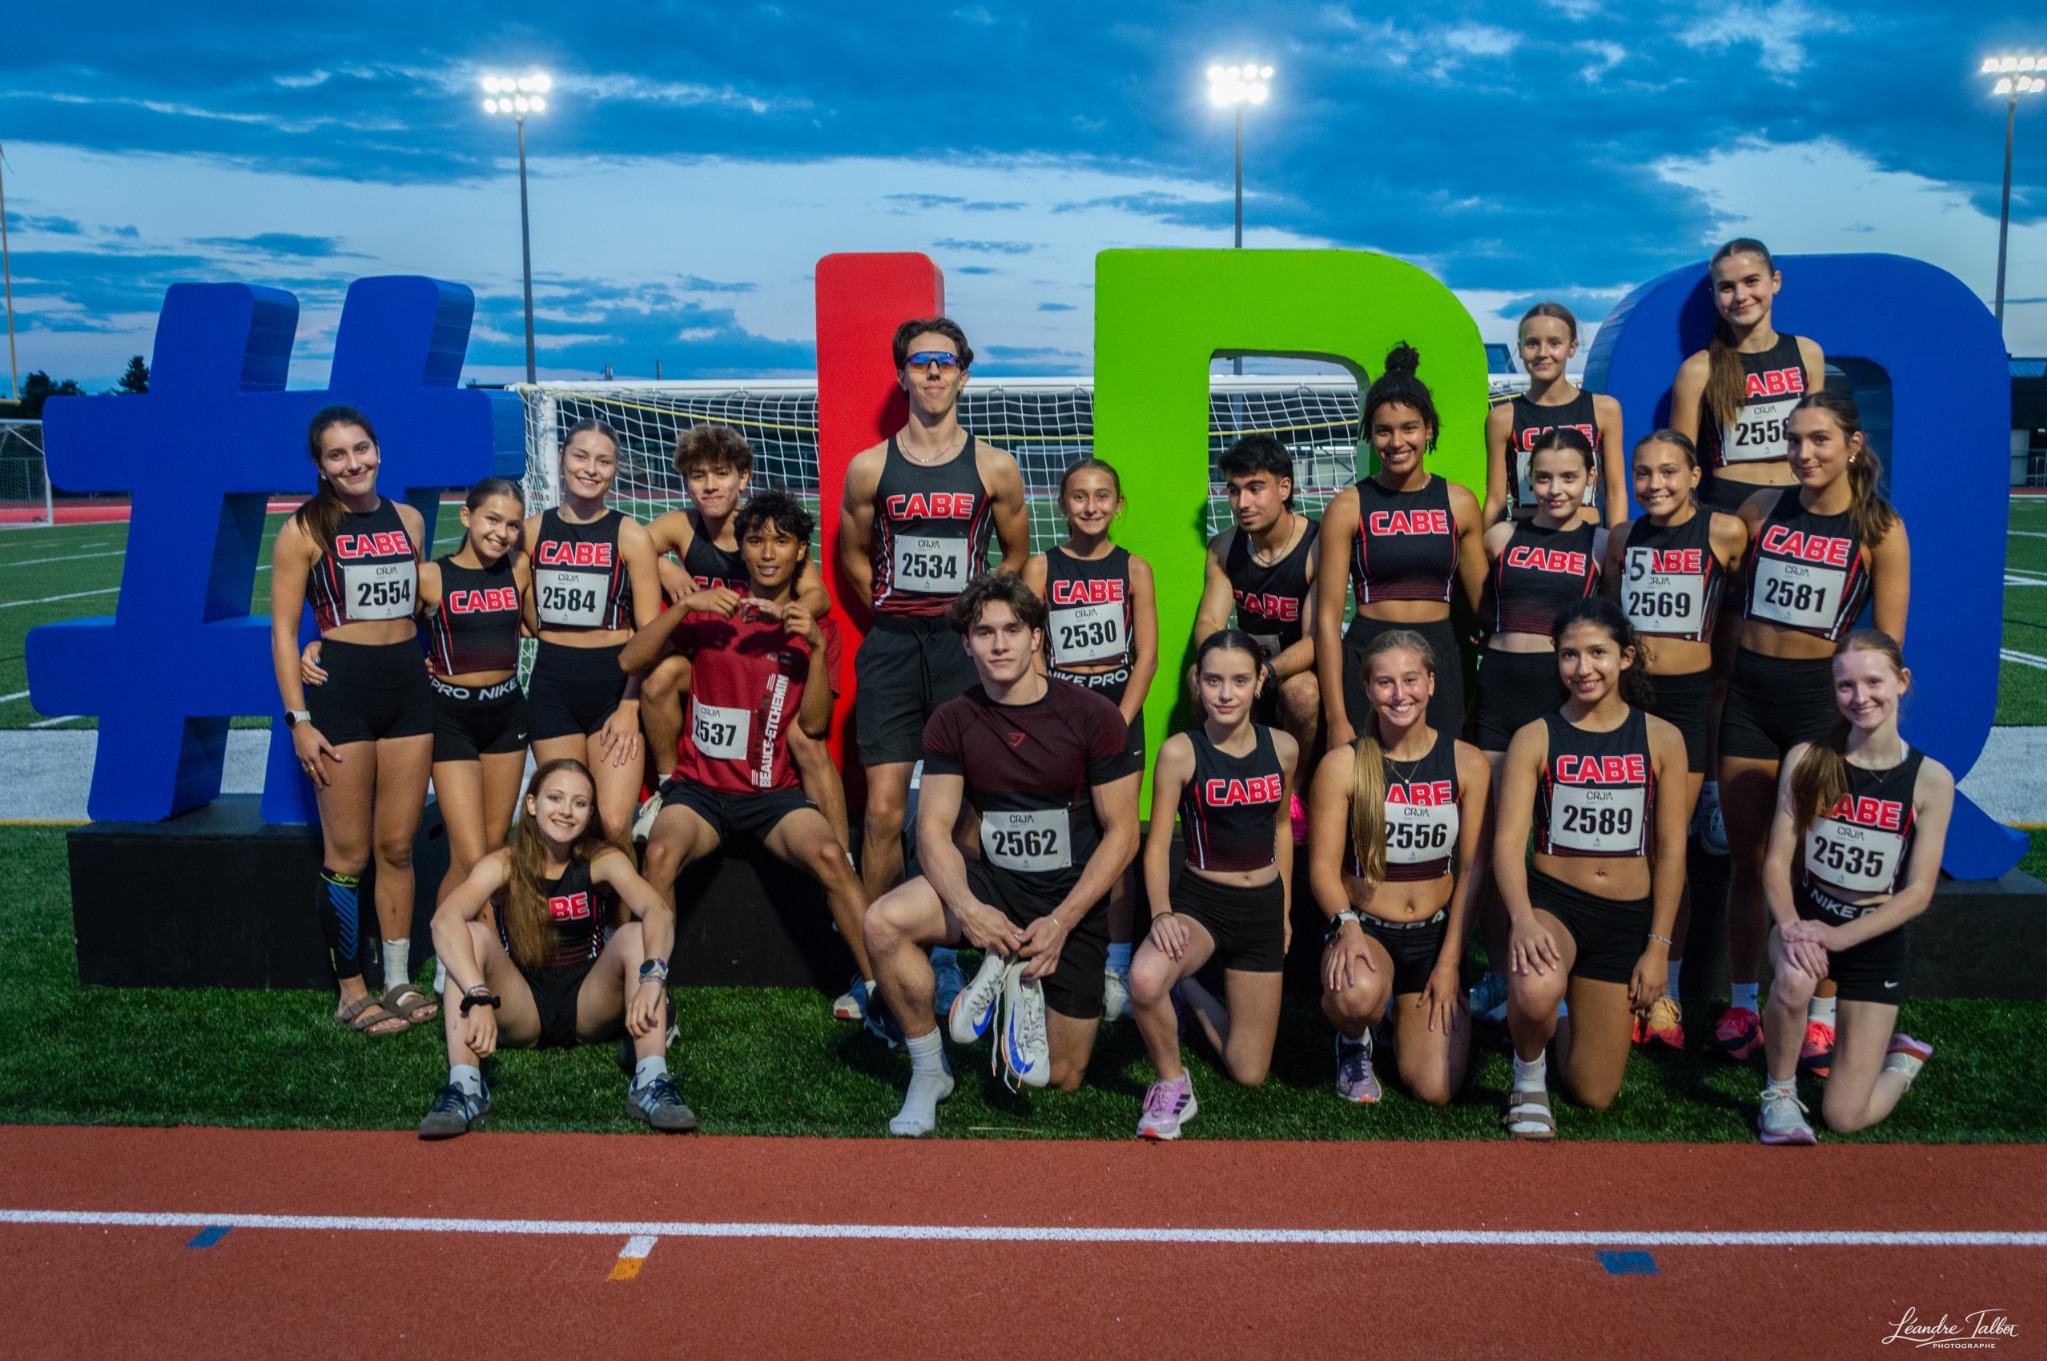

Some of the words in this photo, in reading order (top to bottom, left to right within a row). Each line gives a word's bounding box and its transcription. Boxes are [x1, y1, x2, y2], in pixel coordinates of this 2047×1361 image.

[1746, 367, 1804, 398] ABE
[886, 492, 975, 520] CABE
[1370, 509, 1449, 536] CABE
[336, 531, 412, 559] CABE
[539, 540, 612, 567] CABE
[1762, 524, 1852, 567] CABE
[902, 552, 957, 579] 2534
[1508, 545, 1586, 576] CABE
[1652, 549, 1701, 573] ABE
[357, 578, 410, 606] 2554
[449, 587, 518, 614] CABE
[543, 586, 596, 612] 2584
[1053, 579, 1124, 604] CABE
[1628, 591, 1690, 617] 2569
[1765, 577, 1826, 613] 2581
[1060, 619, 1117, 650] 2530
[430, 677, 470, 700] PRO
[478, 676, 518, 701] NIKE
[1088, 669, 1128, 688] PRO
[695, 714, 737, 747] 2537
[760, 674, 789, 788] BEAUCE-ETCHEMIN
[1557, 754, 1646, 783] CABE
[1206, 773, 1282, 806] CABE
[1385, 780, 1453, 806] ABE
[1562, 805, 1633, 835] 2589
[1830, 794, 1902, 830] ABE
[991, 829, 1058, 857] 2562
[1385, 822, 1448, 849] 2556
[1813, 836, 1884, 877] 2535
[549, 891, 590, 920] BE
[1810, 888, 1857, 919] NIKE
